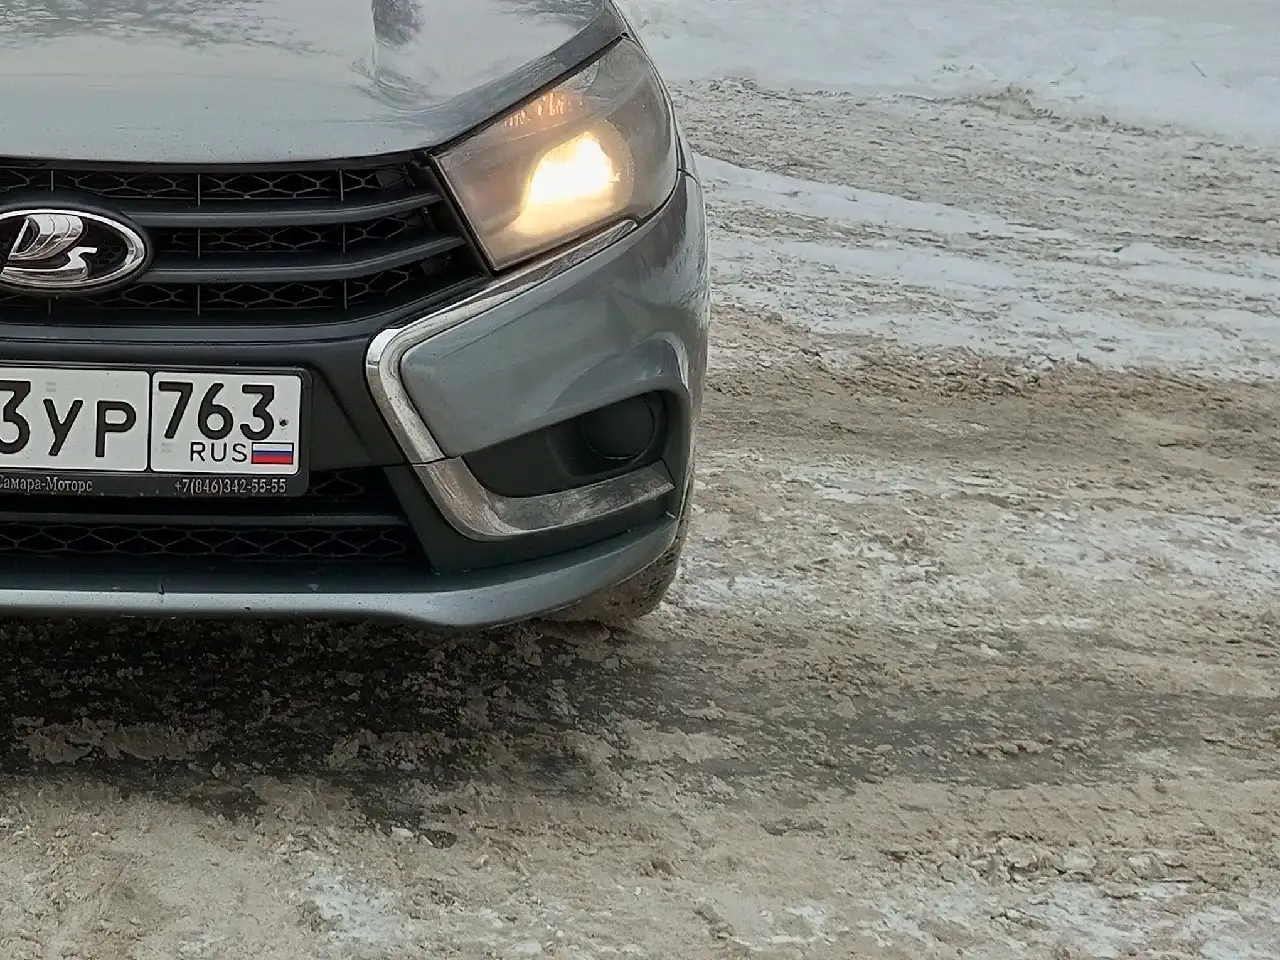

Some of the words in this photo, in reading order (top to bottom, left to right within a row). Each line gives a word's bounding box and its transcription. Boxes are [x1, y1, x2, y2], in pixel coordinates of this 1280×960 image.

[158, 381, 275, 441] 763
[190, 442, 248, 463] RUS
[174, 478, 287, 495] +7(846)342-55-55
